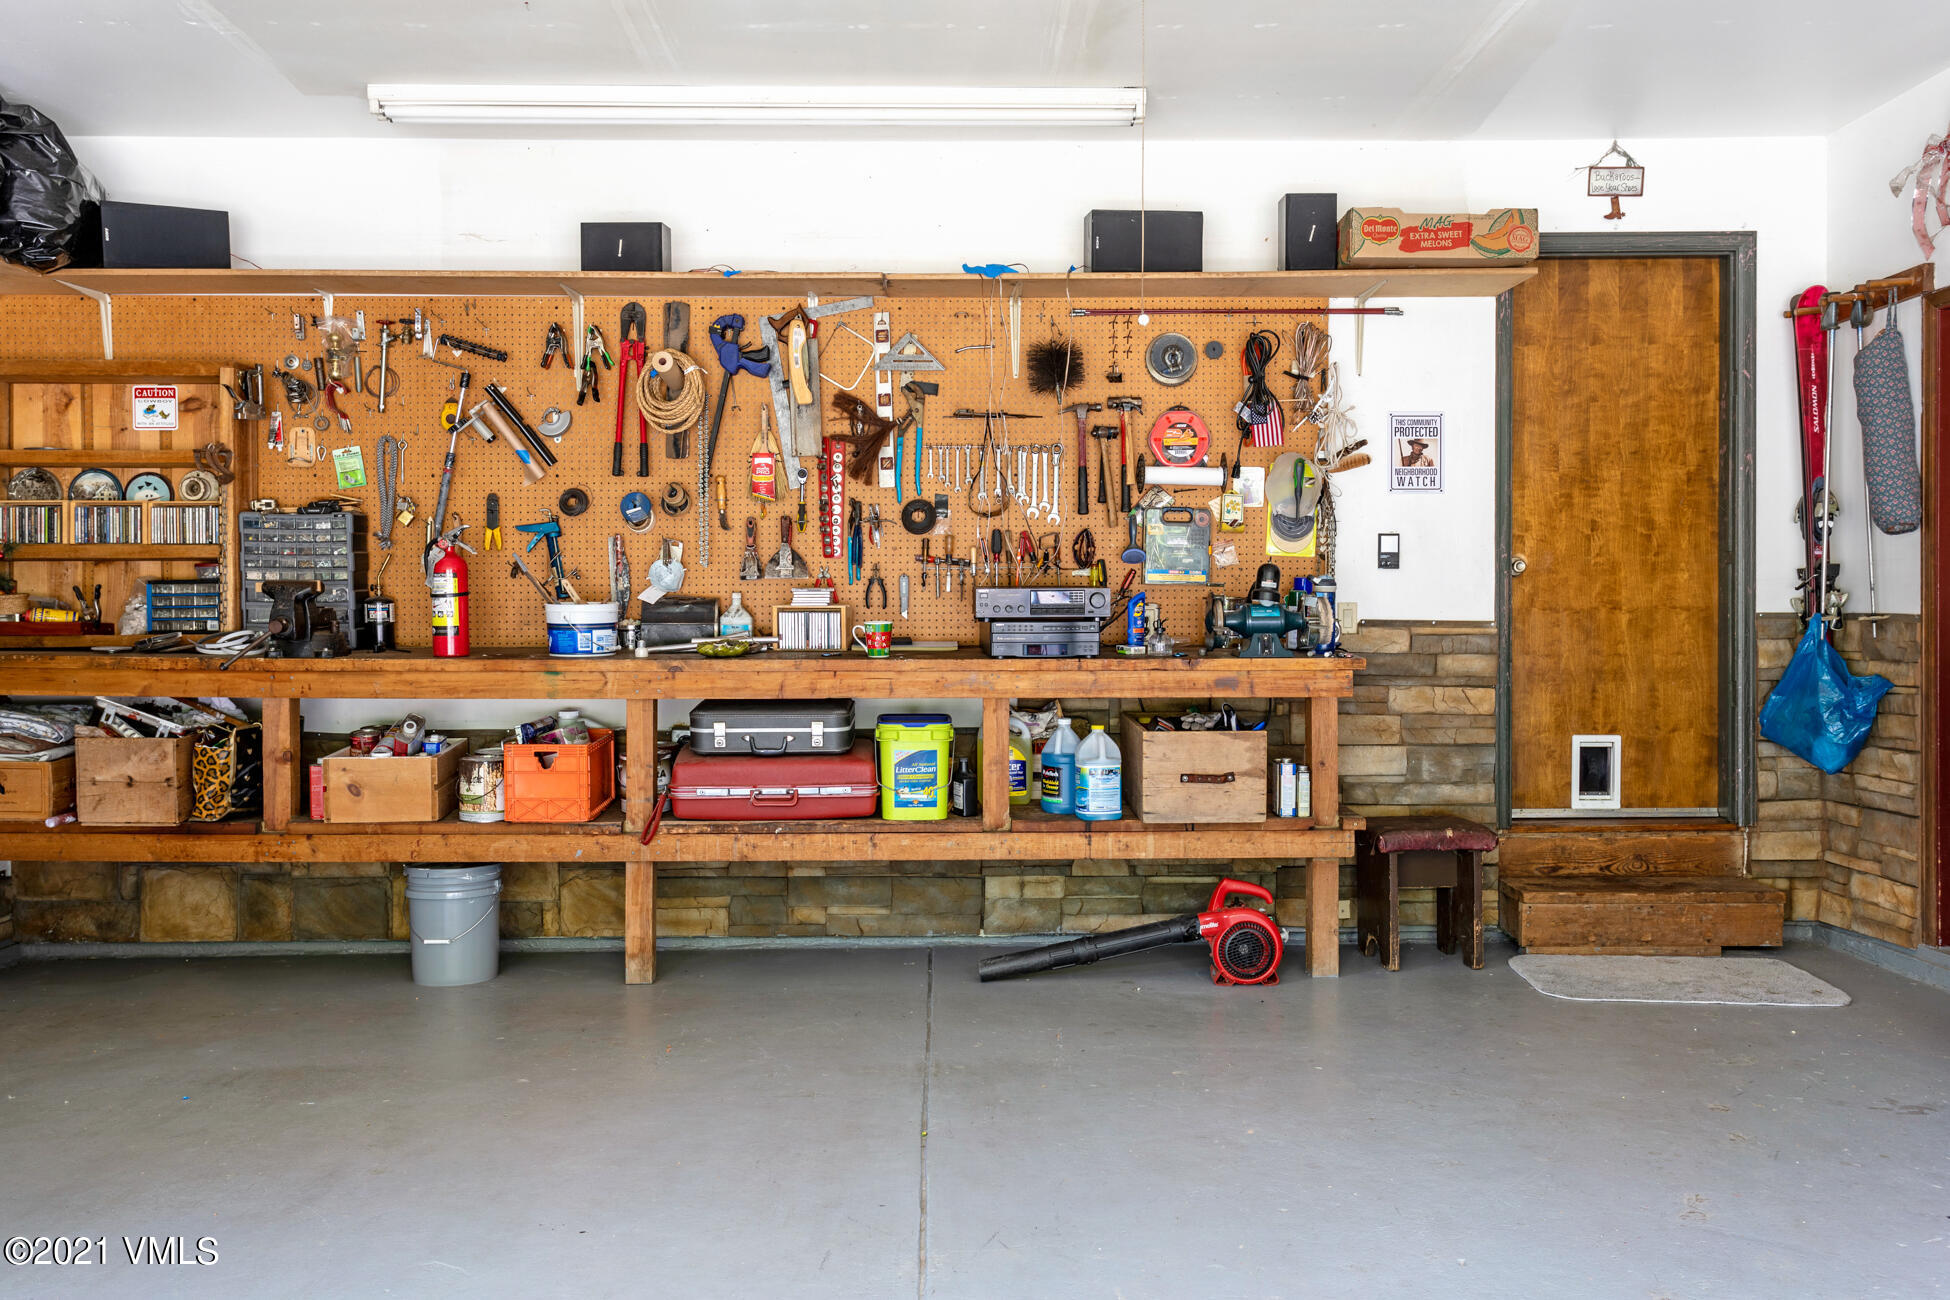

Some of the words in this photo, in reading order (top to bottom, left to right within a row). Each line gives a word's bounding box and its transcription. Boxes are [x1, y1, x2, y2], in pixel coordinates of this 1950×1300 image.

[1419, 216, 1453, 230] MAG
[1363, 224, 1374, 233] Del
[1375, 224, 1397, 232] Monte
[1410, 231, 1435, 240] EXTRA
[1437, 230, 1463, 239] SWEET
[1420, 239, 1453, 248] MELONS
[136, 389, 174, 397] CAUTION
[1811, 384, 1819, 434] SALOMON
[1395, 418, 1406, 426] THIS
[1407, 418, 1438, 426] COMMUNITY
[1394, 426, 1438, 437] PROTECTED
[1394, 468, 1438, 476] NEIGHBORHOOD
[1396, 476, 1436, 487] WATCH
